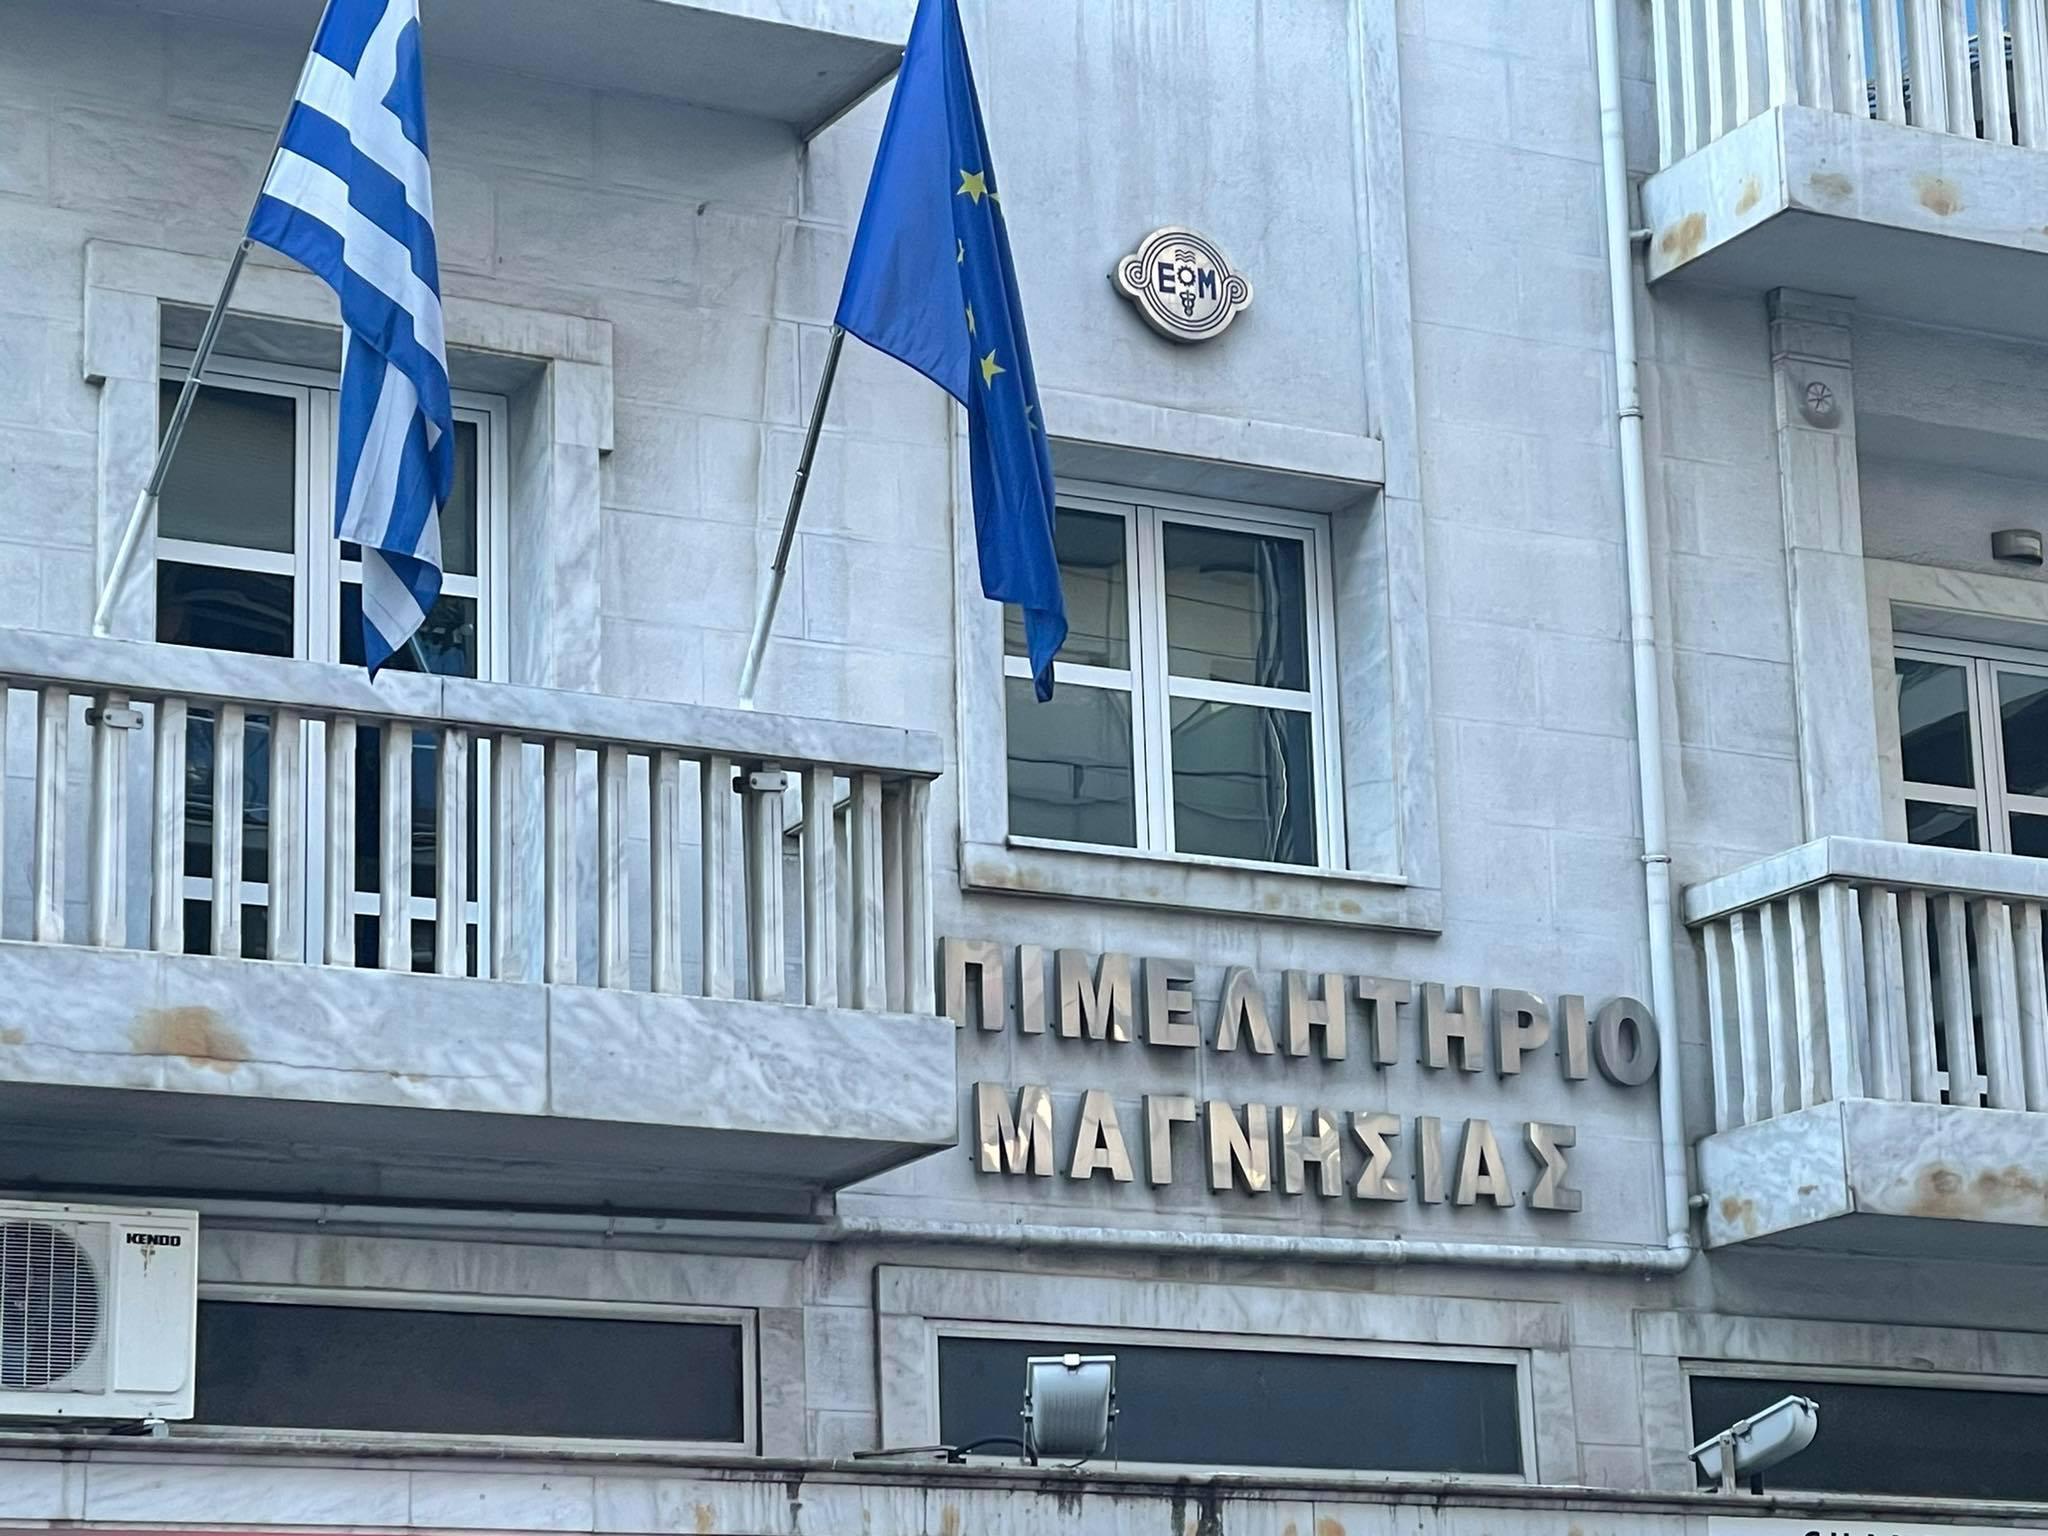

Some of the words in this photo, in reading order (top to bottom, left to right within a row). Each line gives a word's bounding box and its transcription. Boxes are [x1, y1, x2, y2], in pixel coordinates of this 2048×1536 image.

[938, 936, 1660, 1087] ΠΙΜΕΛΗΤΗΡΙΟ
[972, 1082, 1582, 1213] ΜΑΓΝΗΣΙΑΣ
[126, 1232, 181, 1247] KENDO
